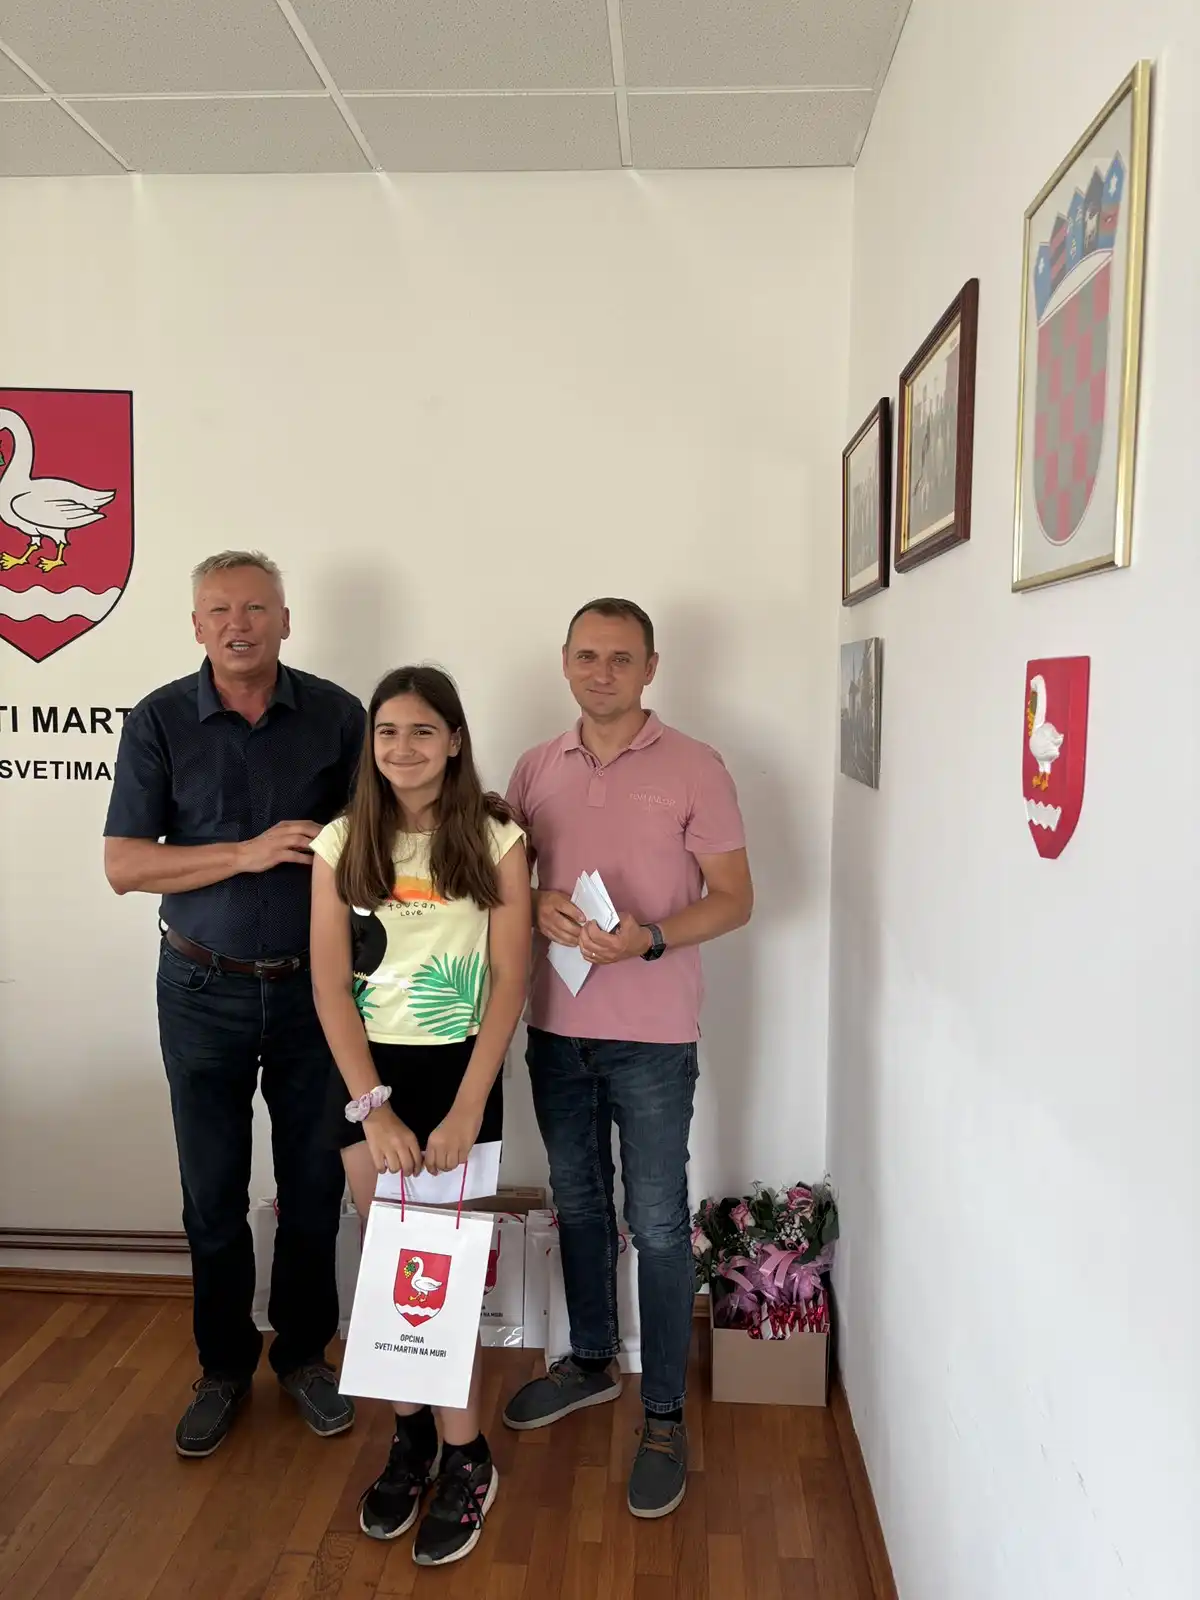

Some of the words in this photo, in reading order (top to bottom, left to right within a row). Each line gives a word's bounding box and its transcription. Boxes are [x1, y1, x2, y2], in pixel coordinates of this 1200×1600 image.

[0, 760, 117, 780] SVETIMA
[388, 902, 436, 911] toucan
[374, 1341, 393, 1352] SVETI
[393, 1344, 418, 1355] MARTIN
[419, 1347, 429, 1356] NA
[429, 1348, 447, 1358] MURI
